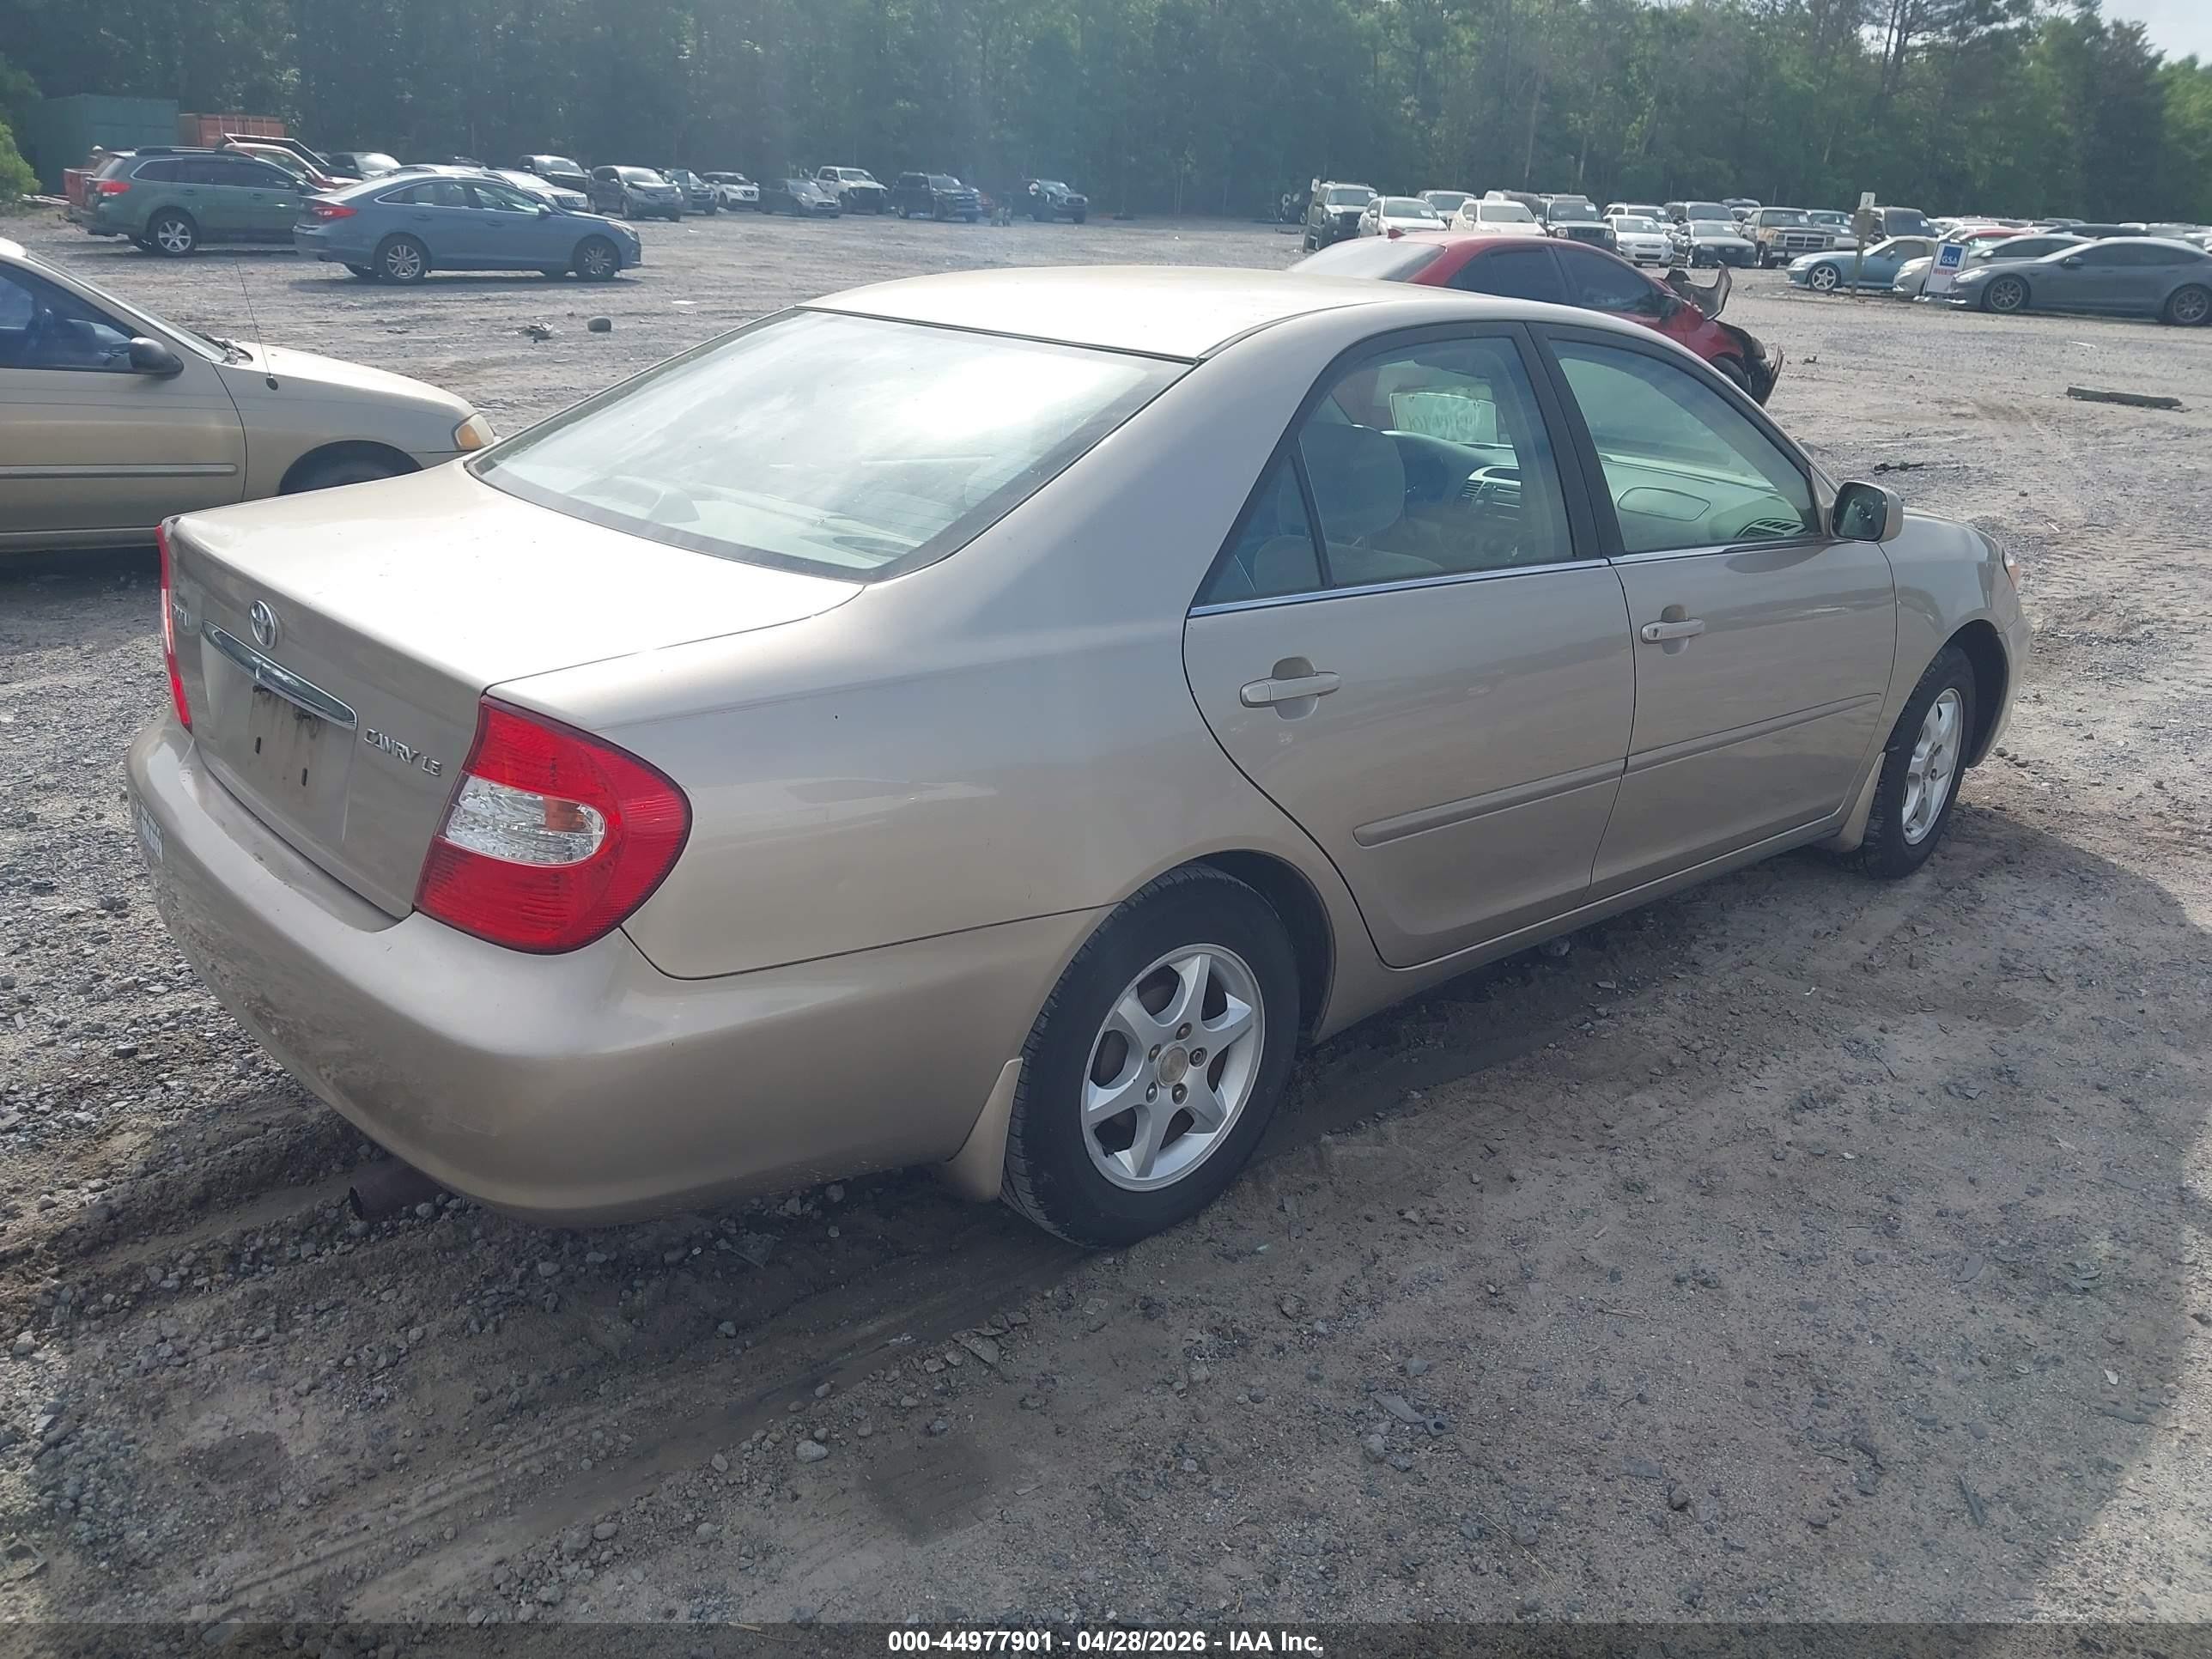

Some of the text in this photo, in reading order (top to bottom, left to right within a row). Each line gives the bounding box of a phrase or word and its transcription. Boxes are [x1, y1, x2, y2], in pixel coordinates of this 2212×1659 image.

[1942, 255, 1958, 264] GSA
[363, 728, 441, 776] CAMRY LE
